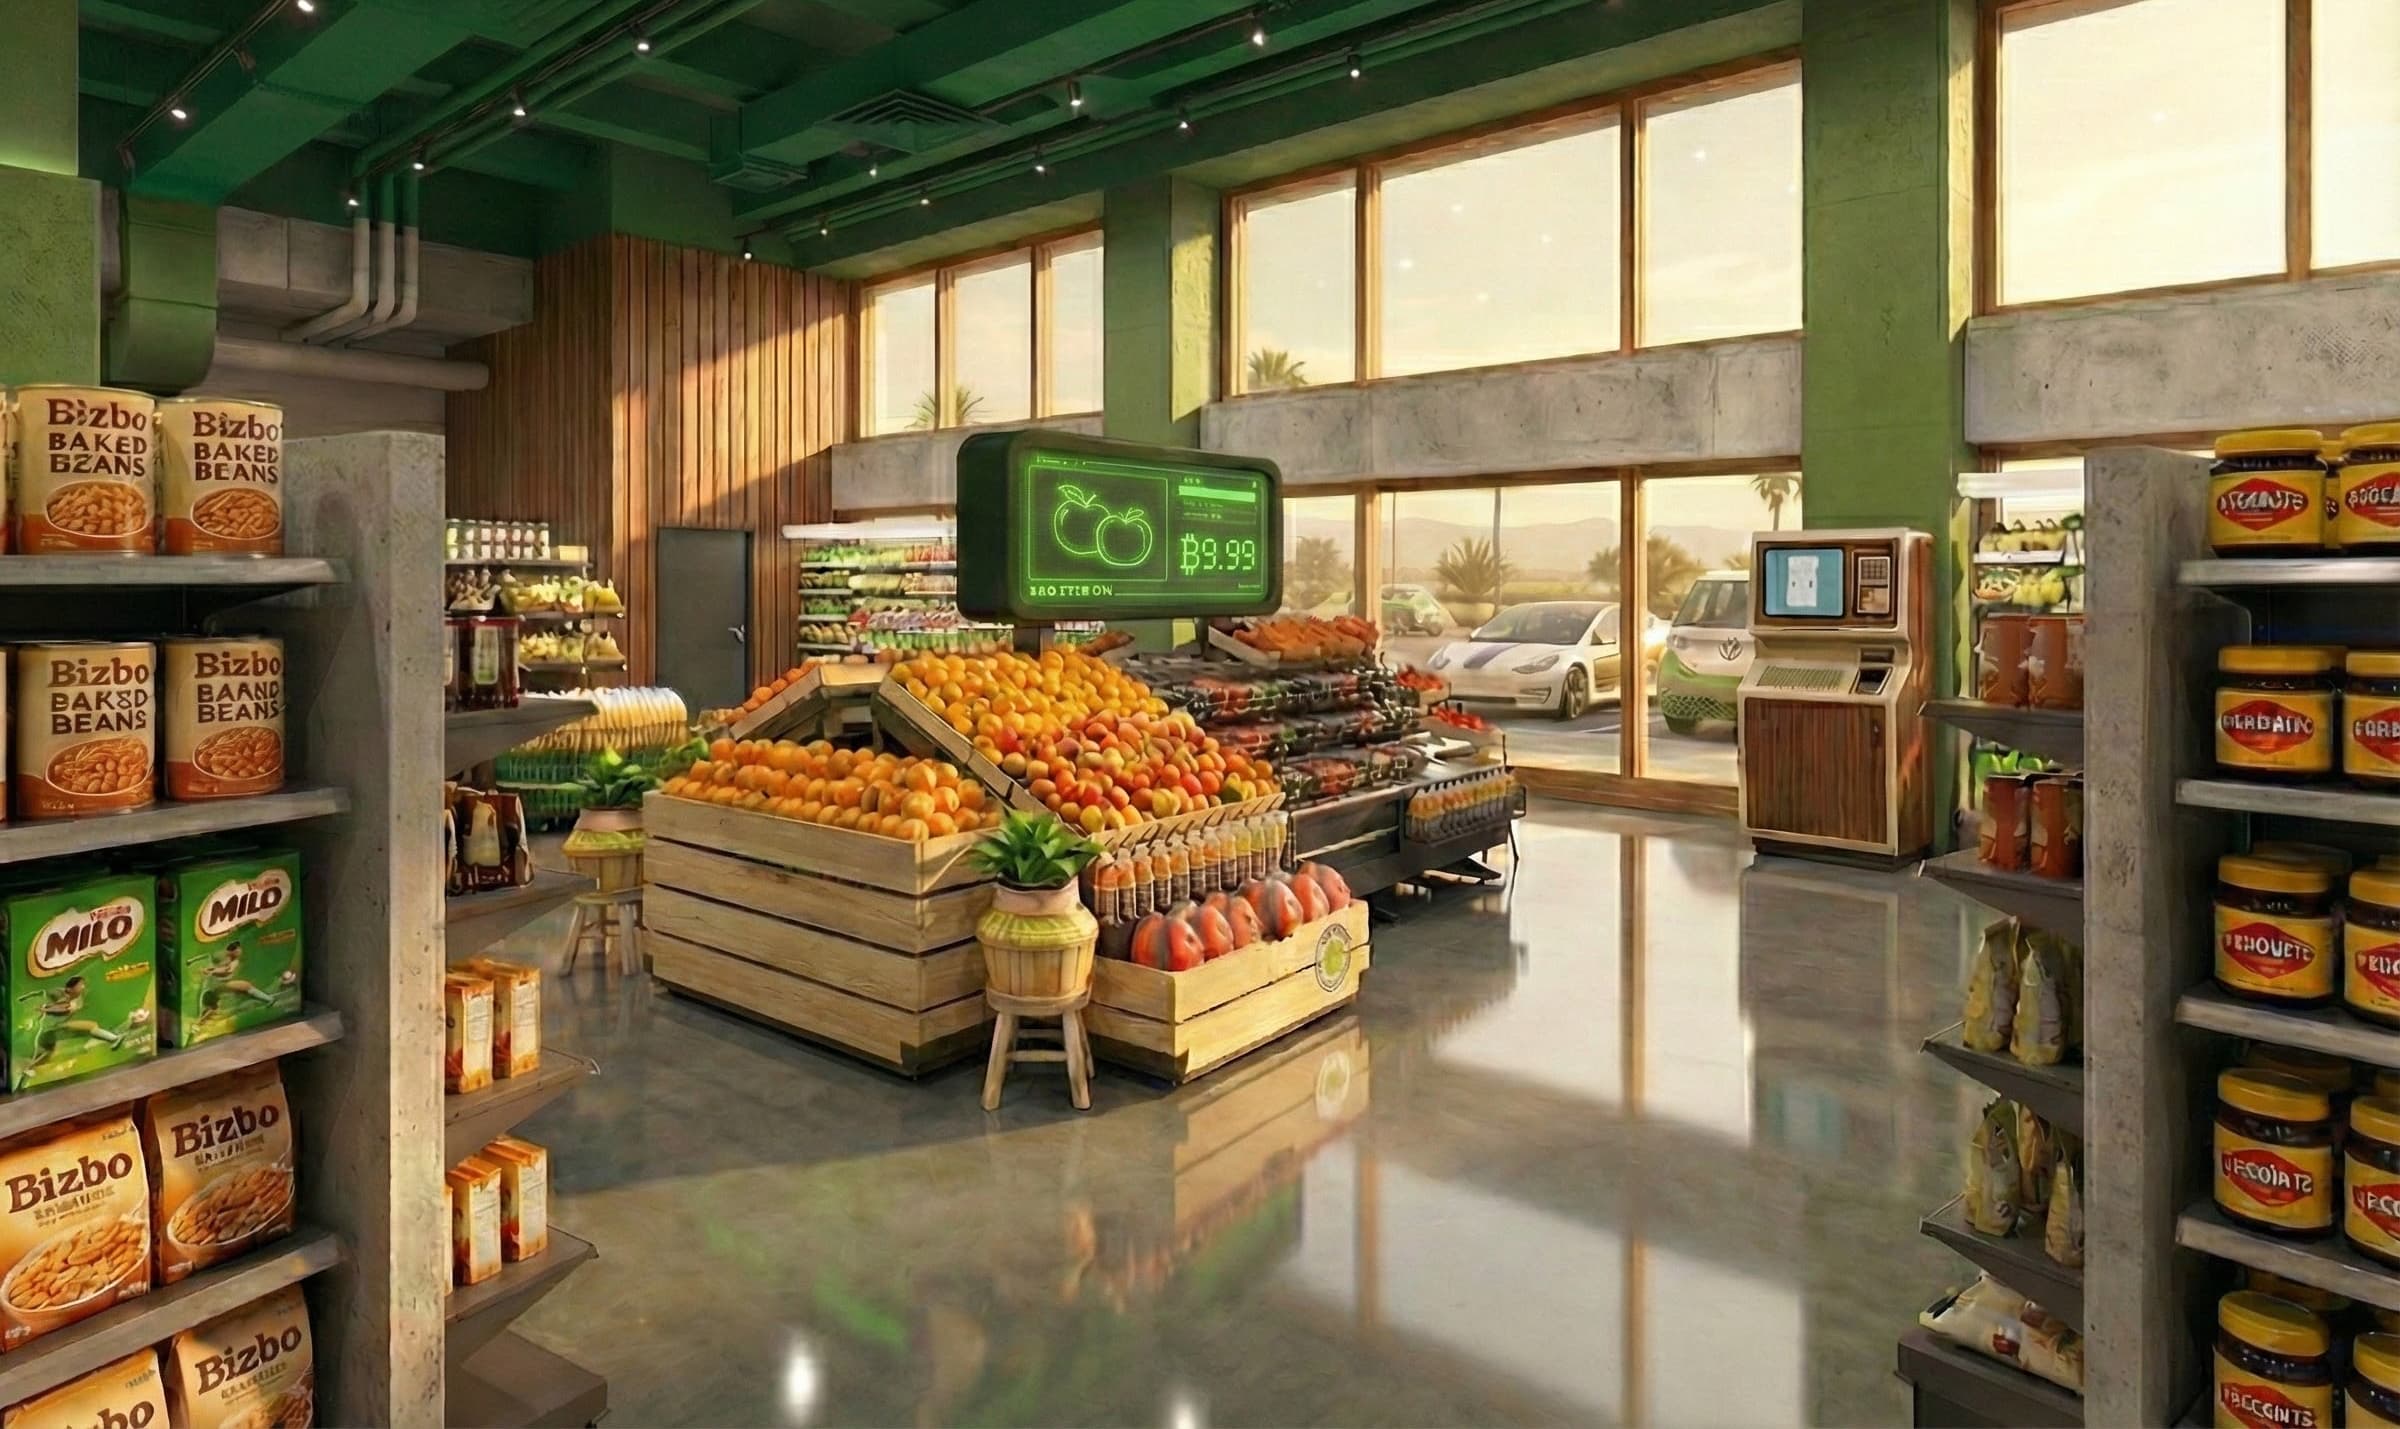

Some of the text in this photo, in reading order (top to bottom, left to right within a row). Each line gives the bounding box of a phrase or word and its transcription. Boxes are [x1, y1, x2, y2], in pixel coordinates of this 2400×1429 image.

[47, 398, 147, 431] Bizbo
[192, 411, 280, 442] Bizbo
[48, 432, 148, 455] BAKED
[195, 462, 279, 485] BEANS
[48, 657, 149, 688] Bizbo
[194, 651, 281, 679] Bizbo
[52, 709, 147, 735] BEANS
[197, 700, 279, 724] BEANS
[209, 885, 283, 929] MILO
[43, 914, 133, 962] MILO
[171, 1103, 280, 1158] Bizbo
[5, 1152, 133, 1213] Bizbo
[195, 1326, 302, 1395] Bizbo
